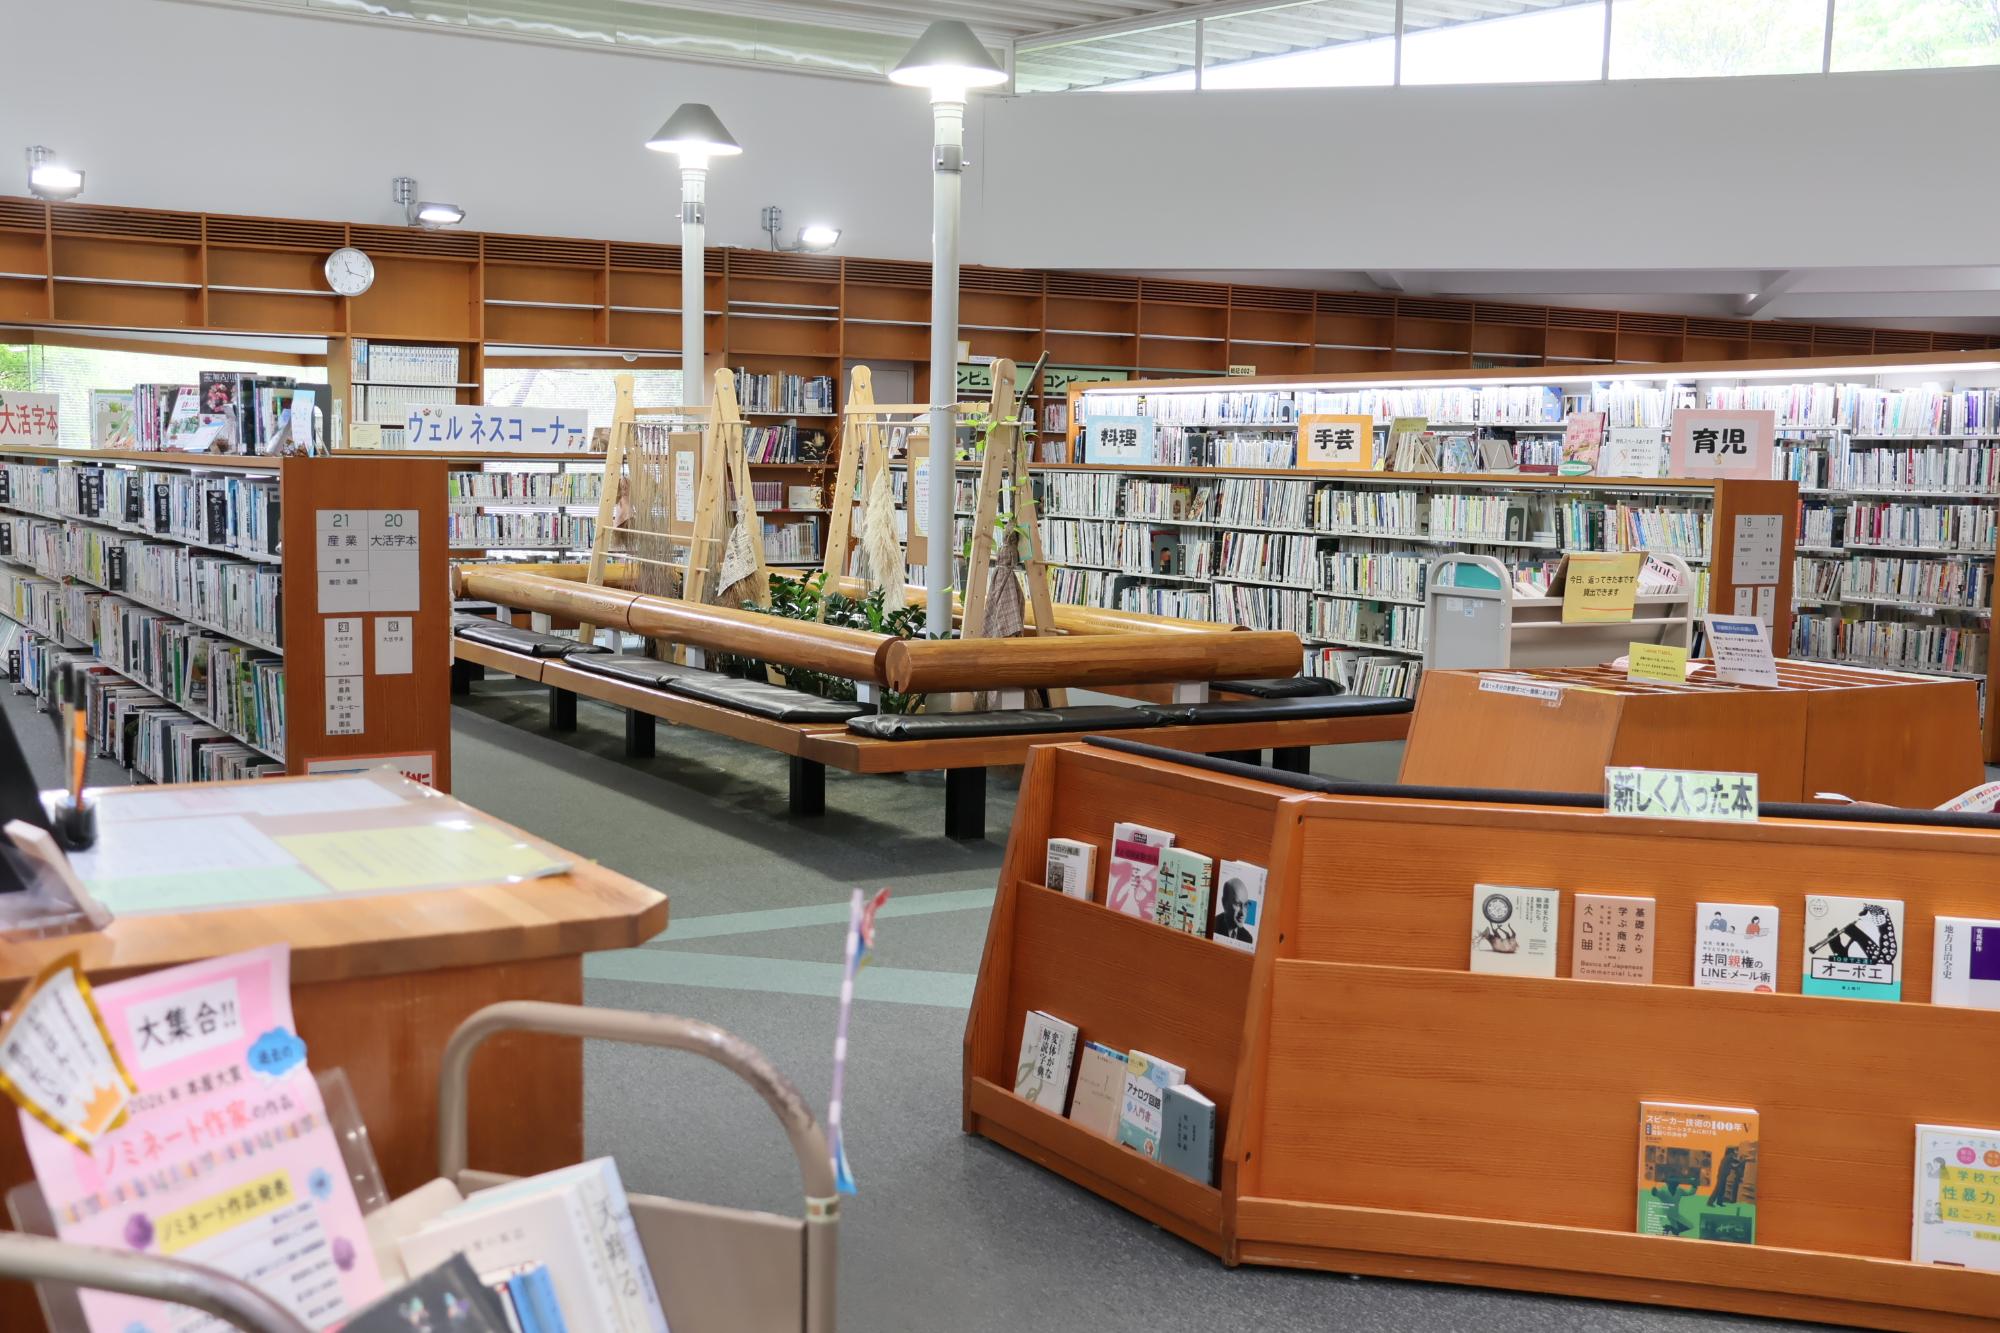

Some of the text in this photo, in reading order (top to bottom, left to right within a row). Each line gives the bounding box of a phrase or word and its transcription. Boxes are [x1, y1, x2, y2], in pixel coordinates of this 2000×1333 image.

[957, 371, 990, 386] ンピュ
[0, 403, 58, 435] 大活字本
[408, 411, 583, 445] ウェルネスコーナー
[1100, 428, 1137, 447] 料理
[1314, 429, 1355, 450] 手芸
[1692, 427, 1747, 455] 育児
[333, 513, 349, 527] 21
[384, 513, 403, 527] 20
[1743, 517, 1752, 527] 18
[1767, 517, 1776, 527] 17
[370, 534, 417, 547] 大活字本
[1645, 556, 1678, 582] Pants
[1613, 771, 1753, 818] 新しく入った本
[1617, 907, 1627, 952] 学ぶ商法
[1635, 908, 1645, 954] 基礎から
[1702, 953, 1763, 968] 共同親権の
[1943, 924, 1954, 980] 地方自治全史
[1701, 967, 1771, 983] LINE・メール術
[1822, 963, 1882, 979] オーボエ
[1044, 1032, 1059, 1079] 変体がな
[1127, 1082, 1161, 1110] アナログ回路
[1942, 1186, 2000, 1206] 性暴力
[1947, 1207, 1996, 1222] 起こった
